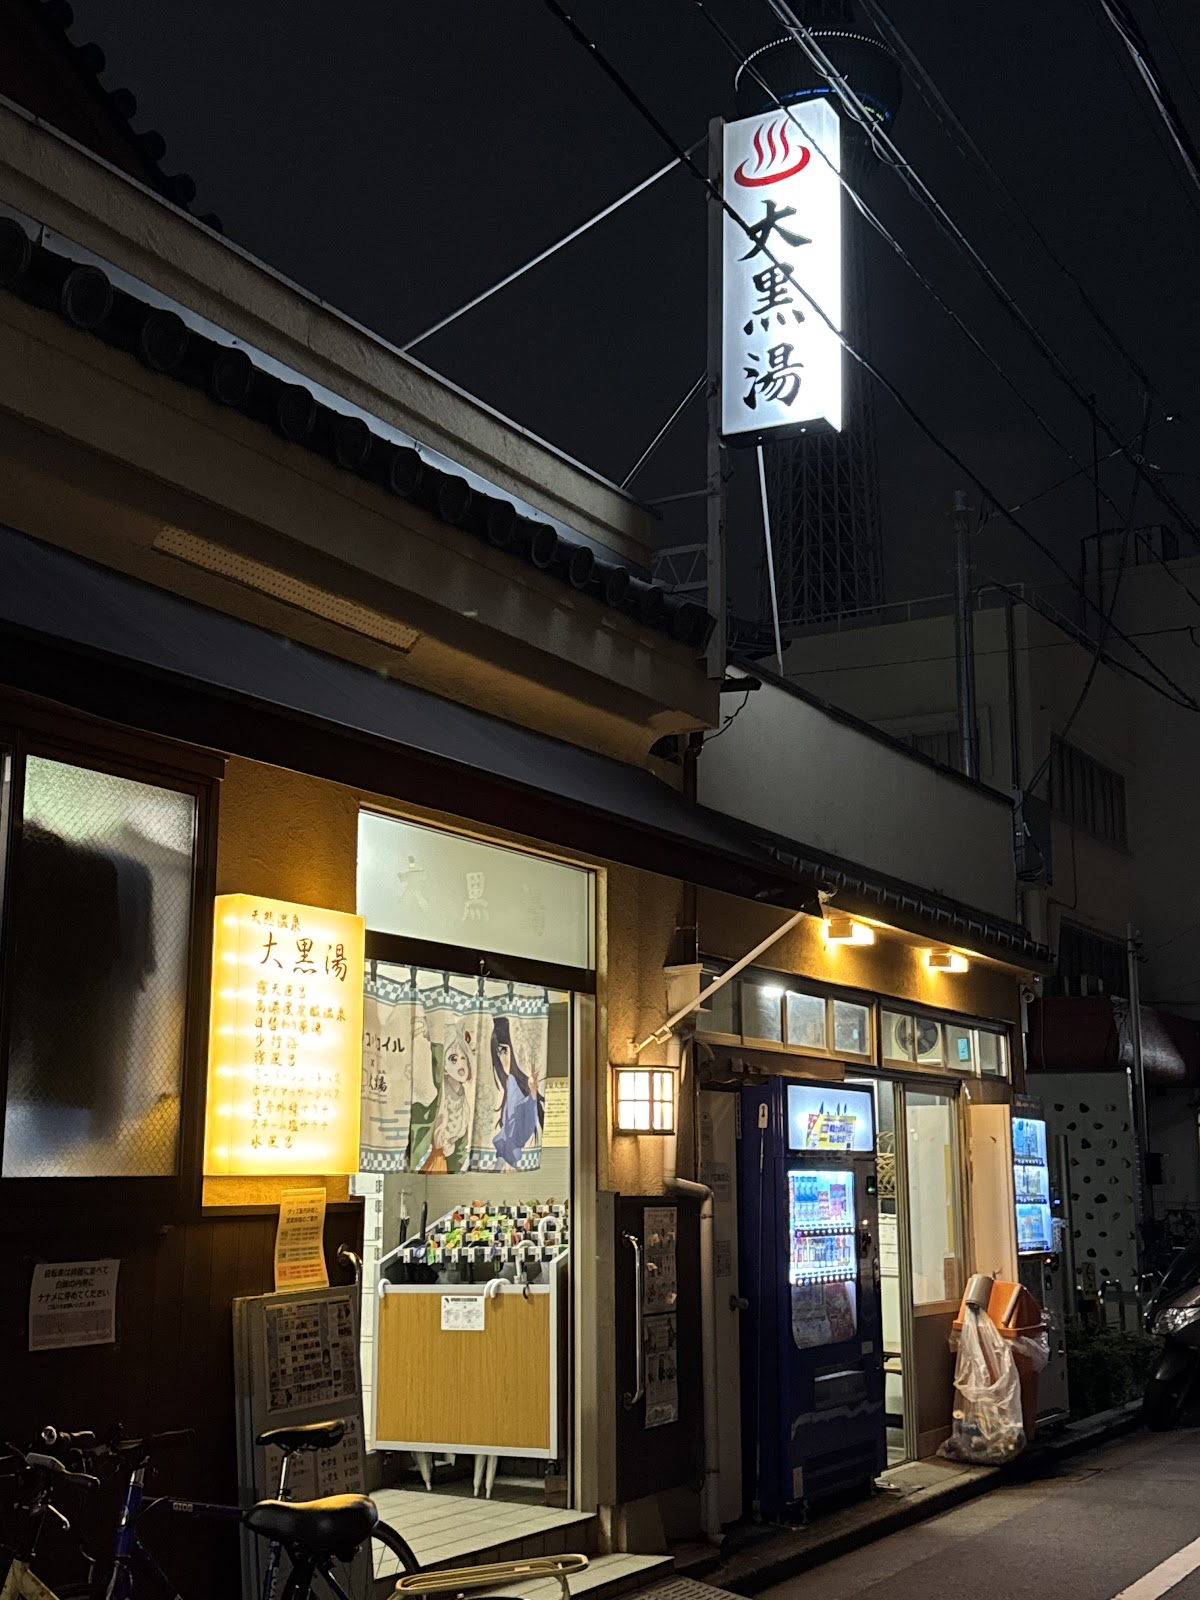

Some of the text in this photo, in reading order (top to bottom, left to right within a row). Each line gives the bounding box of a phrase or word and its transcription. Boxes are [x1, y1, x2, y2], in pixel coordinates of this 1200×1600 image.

[738, 199, 813, 410] 大黒湯
[251, 910, 300, 932] 天然温泉
[260, 931, 348, 982] 大黒湯
